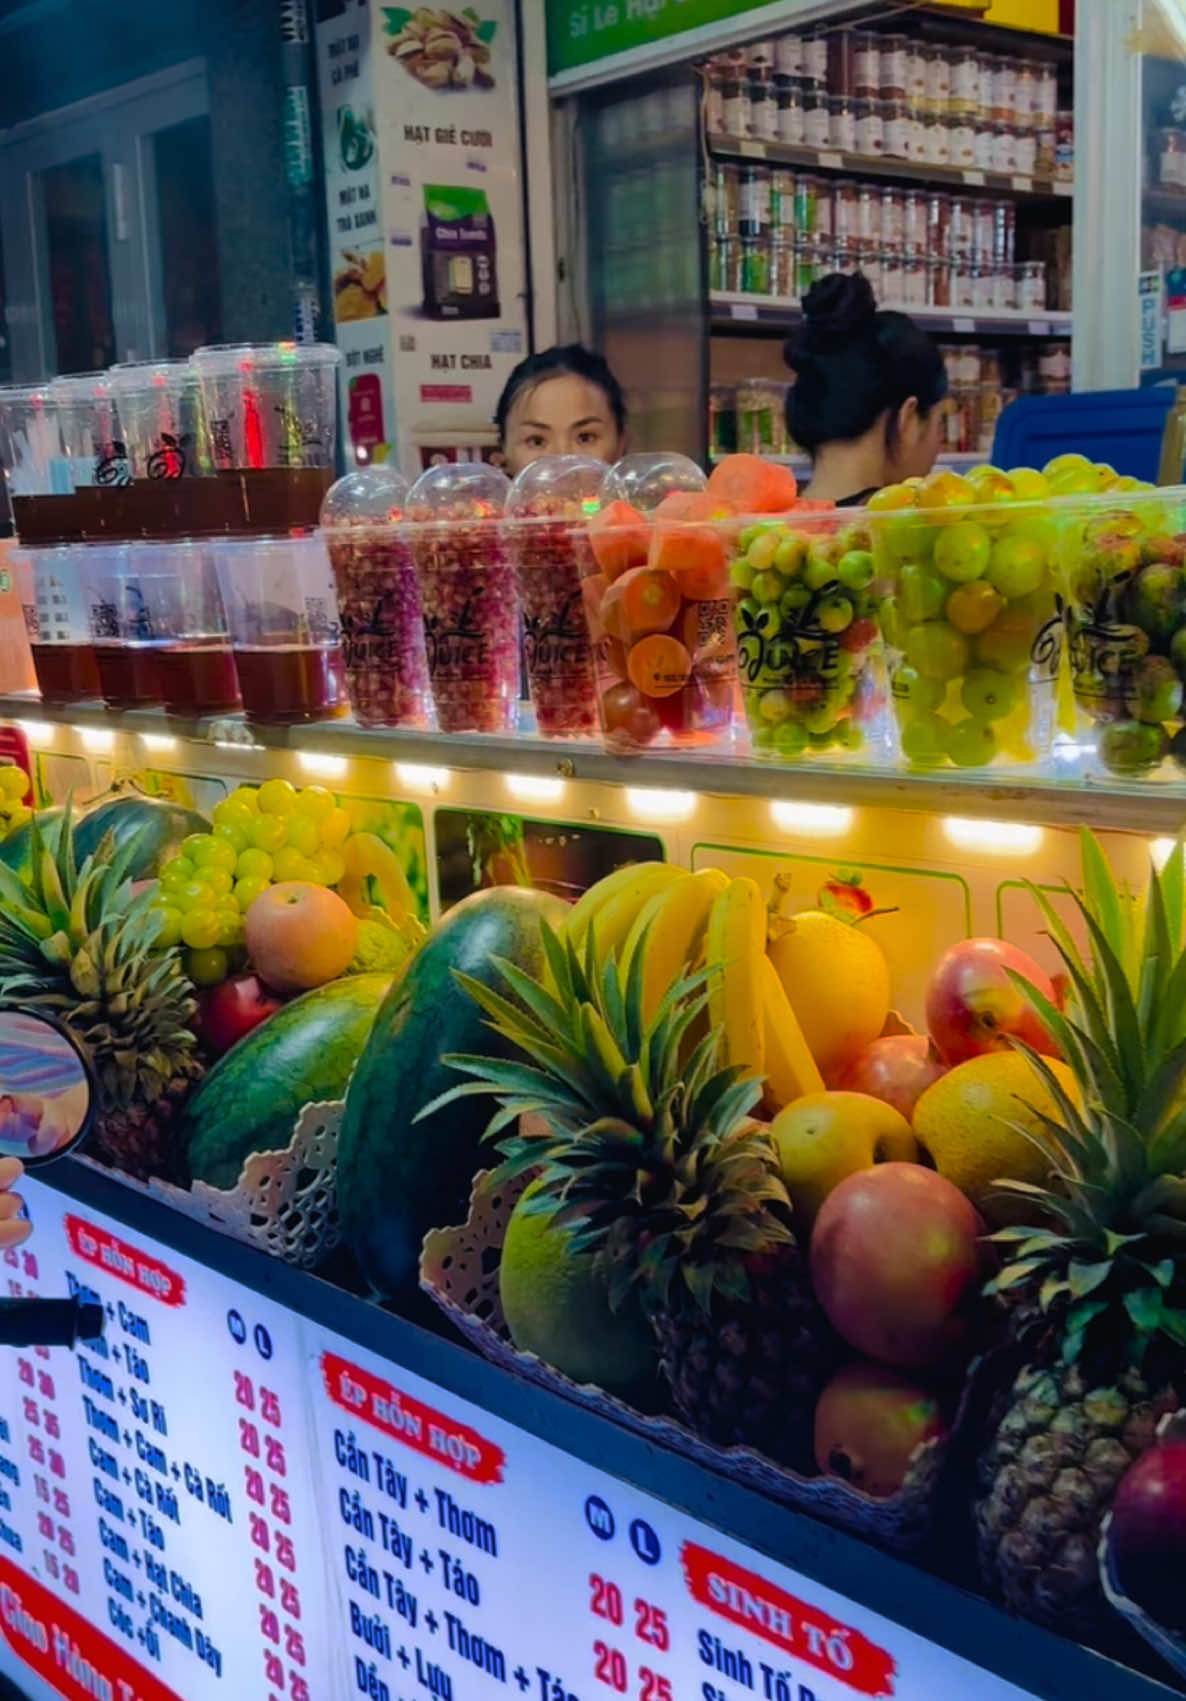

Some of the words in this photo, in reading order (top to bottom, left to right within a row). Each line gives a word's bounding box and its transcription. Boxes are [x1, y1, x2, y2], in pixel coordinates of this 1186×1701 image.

[459, 353, 493, 370] CHIA
[118, 1300, 151, 1346] Cam
[117, 1387, 126, 1406] +
[234, 1370, 255, 1411] 20
[259, 1386, 282, 1428] 25
[88, 1435, 119, 1480] Cam
[122, 1467, 131, 1486] +
[123, 1429, 132, 1448] +
[135, 1430, 168, 1476] Cam
[170, 1461, 180, 1482] +
[239, 1417, 260, 1459] 20
[264, 1434, 286, 1477] 25
[427, 1422, 482, 1470] HỢP
[93, 1476, 124, 1522] Cam
[127, 1508, 136, 1527] +
[244, 1465, 265, 1506] 20
[269, 1482, 291, 1525] 25
[372, 1450, 407, 1510] Tây
[414, 1487, 430, 1514] +
[434, 1486, 499, 1558] Thơm
[98, 1516, 130, 1562] Cam
[132, 1550, 141, 1568] +
[249, 1511, 270, 1552] 20
[274, 1530, 296, 1572] 25
[378, 1511, 412, 1569] Tây
[419, 1549, 434, 1575] +
[438, 1549, 481, 1607] Táo
[103, 1557, 134, 1602] Cam
[136, 1591, 146, 1608] +
[254, 1557, 275, 1599] 20
[279, 1577, 301, 1620] 25
[259, 1603, 280, 1645] 20
[284, 1623, 306, 1667] 25
[382, 1570, 417, 1629] Tây
[424, 1609, 440, 1635] +
[443, 1609, 507, 1684] Thơm
[513, 1665, 531, 1692] +
[536, 1666, 581, 1701] Tá
[589, 1572, 623, 1628] 20
[634, 1597, 670, 1653] 25
[706, 1571, 795, 1641] SINH
[801, 1620, 854, 1671] TỐ
[264, 1648, 285, 1690] 20
[396, 1645, 411, 1670] +
[593, 1639, 628, 1695] 20
[638, 1665, 674, 1701] 25
[697, 1628, 754, 1691] Sinh
